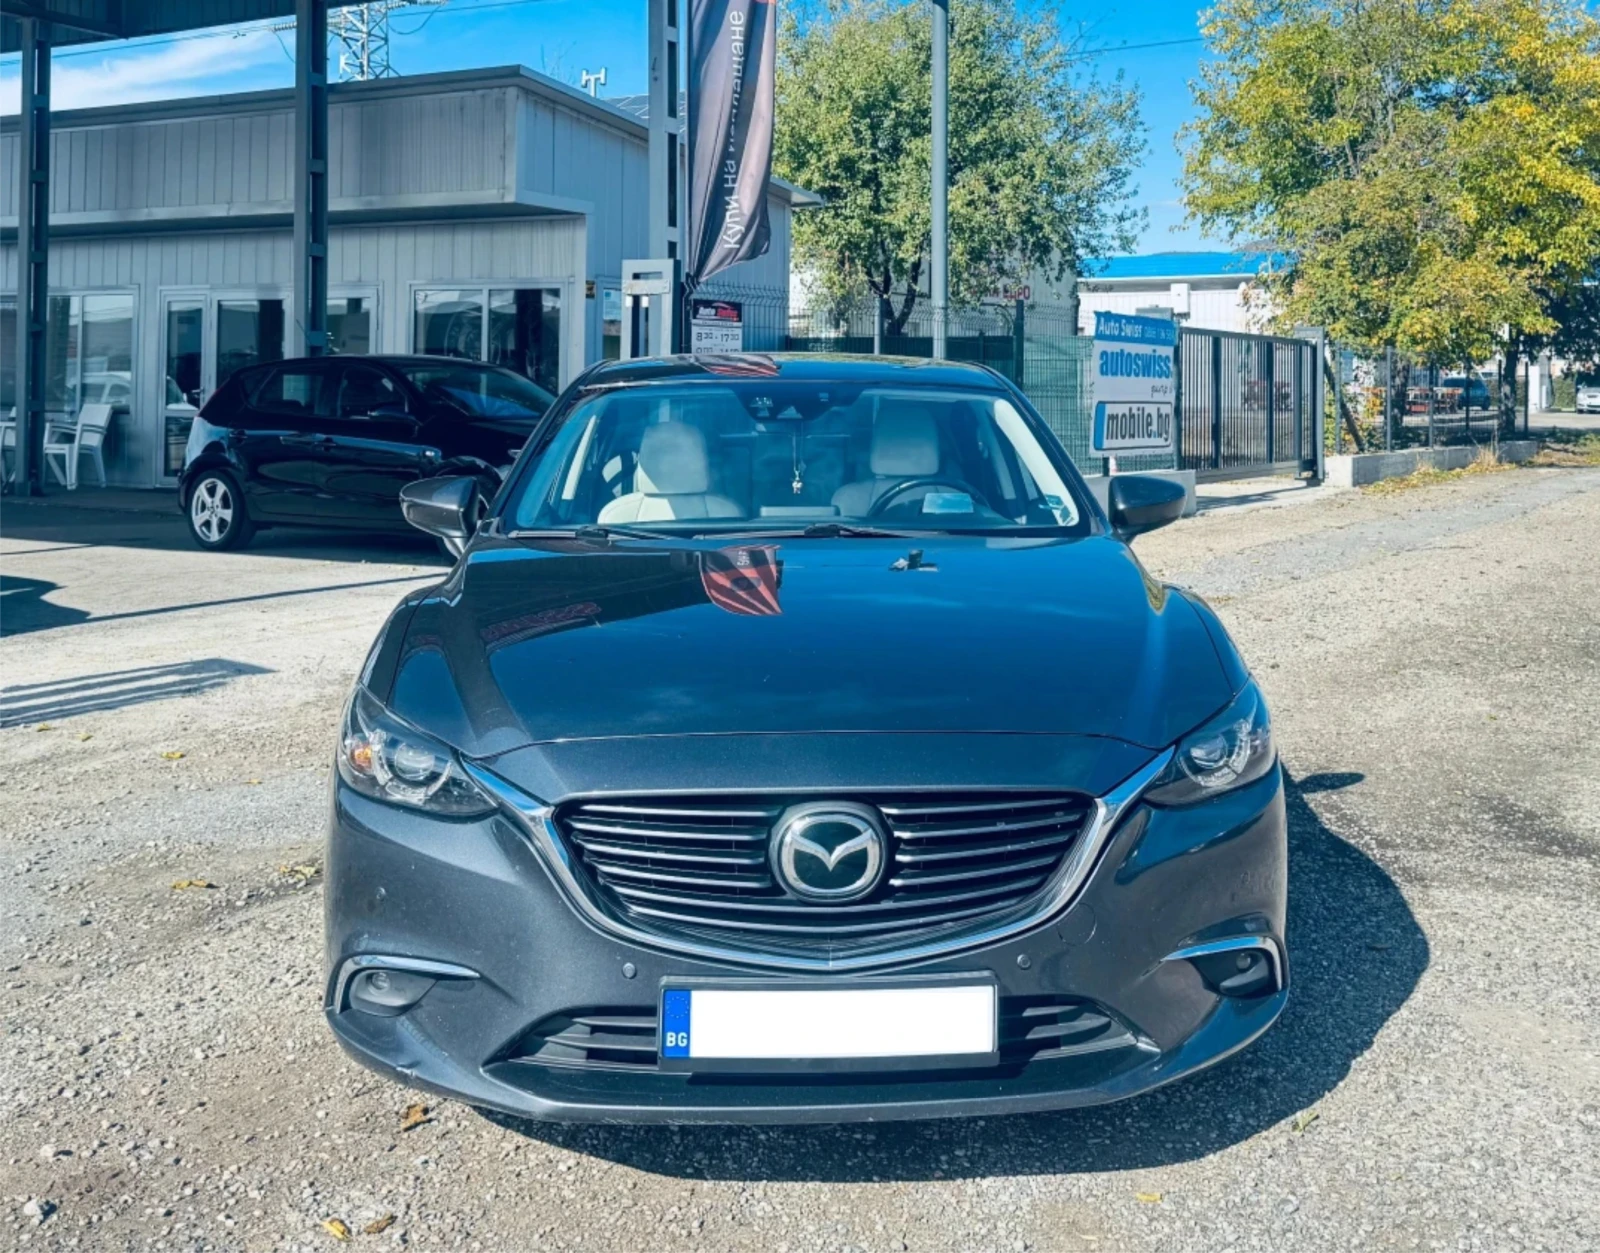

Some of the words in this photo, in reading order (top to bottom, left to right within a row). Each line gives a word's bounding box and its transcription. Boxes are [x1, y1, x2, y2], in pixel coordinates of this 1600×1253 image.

[724, 160, 738, 188] на
[722, 195, 745, 249] Купи
[1098, 316, 1119, 336] Auto
[1121, 319, 1142, 338] Swiss
[1106, 406, 1171, 443] mobile.bg
[666, 1032, 688, 1047] BG
